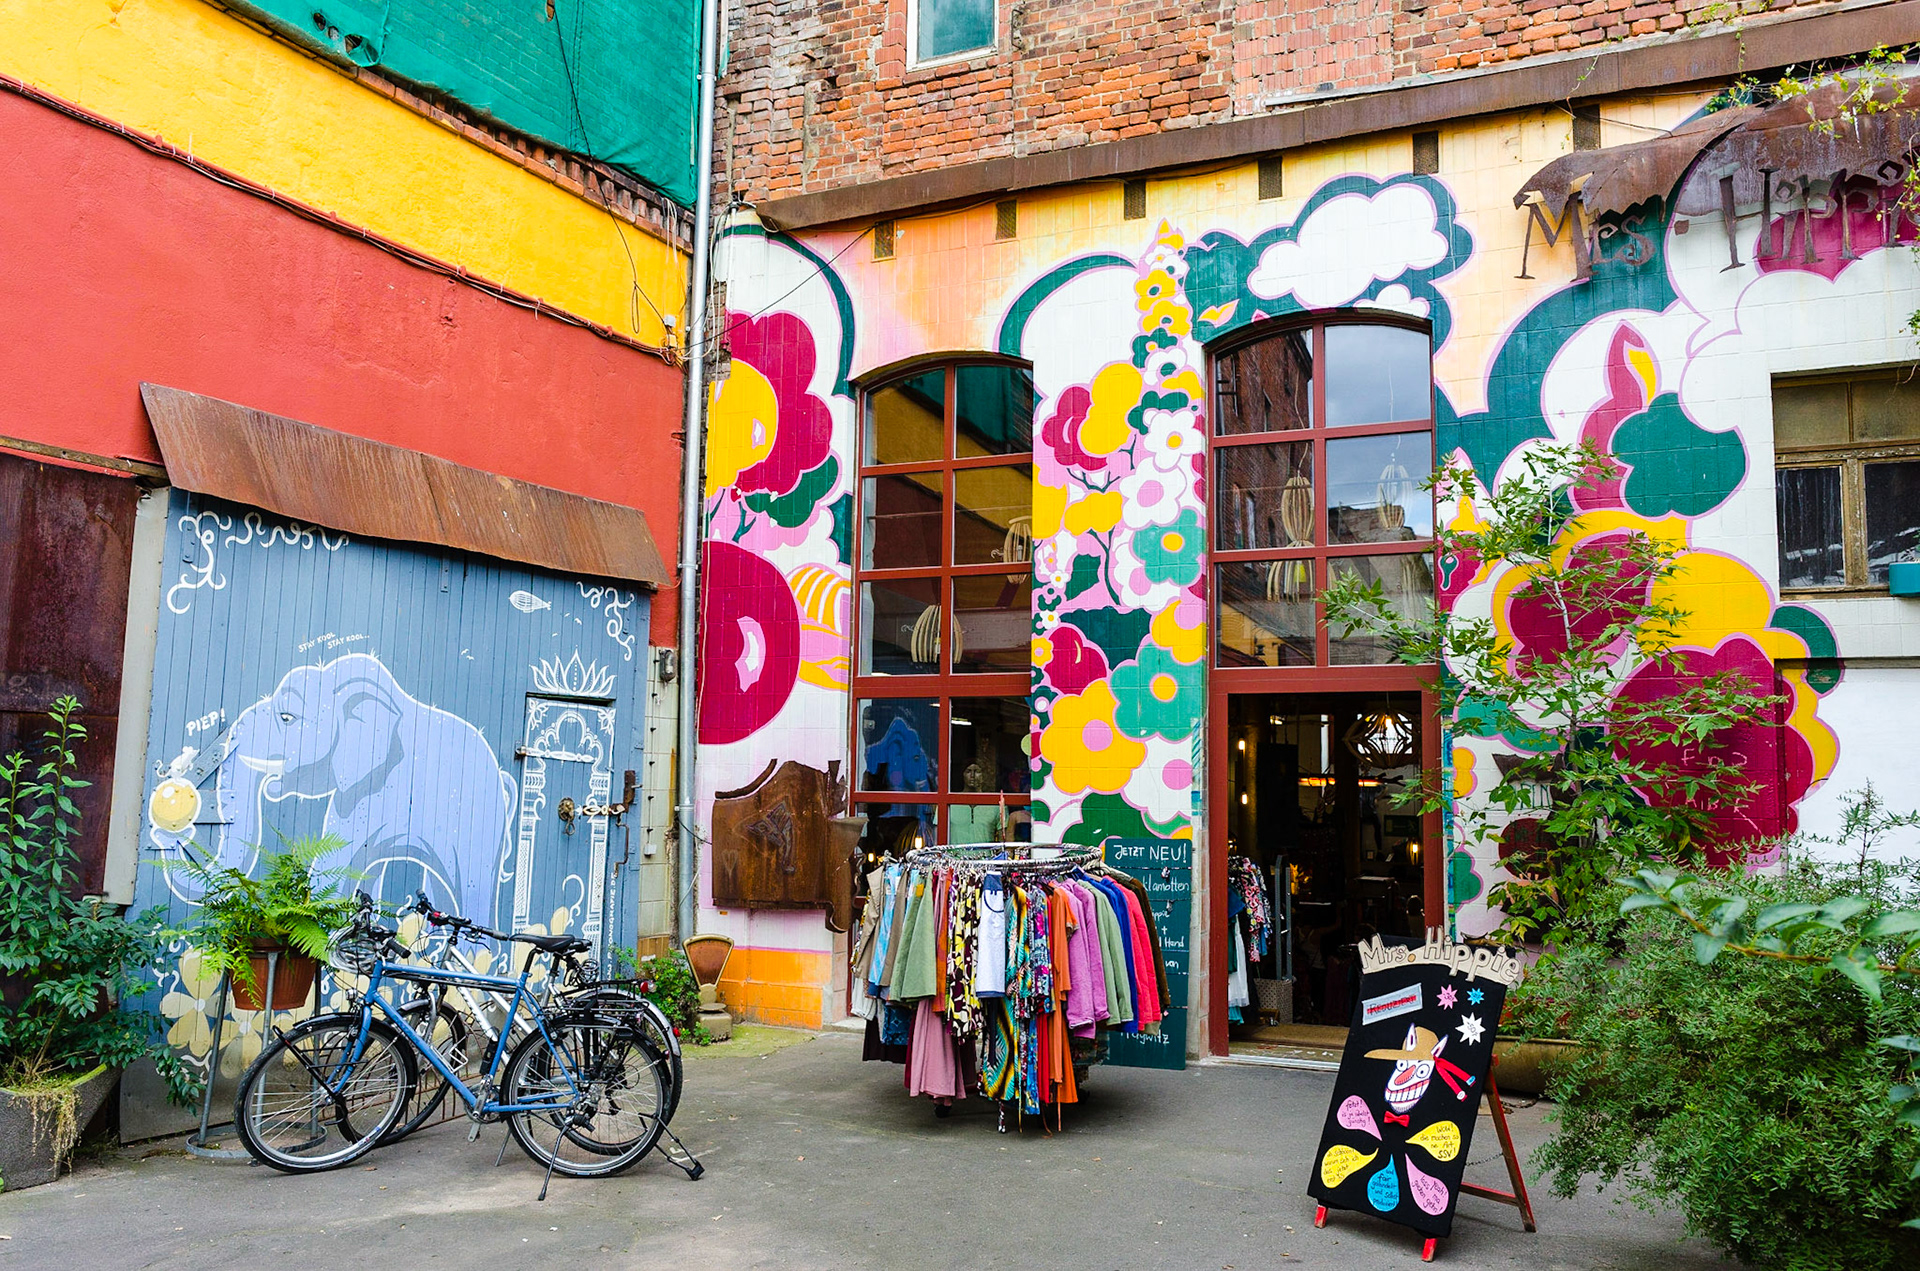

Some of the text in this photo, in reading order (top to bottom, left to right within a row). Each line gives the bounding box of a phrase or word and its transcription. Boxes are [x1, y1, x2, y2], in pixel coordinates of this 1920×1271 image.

[298, 631, 336, 653] STAY KOOL
[327, 637, 344, 649] STAY
[186, 707, 226, 736] PIEP!
[1149, 842, 1187, 863] NEU!
[1152, 909, 1171, 921] ippie
[1164, 935, 1185, 948] Hand
[1358, 926, 1521, 982] Mrs. Hippie
[1121, 1029, 1169, 1045] agwitz
